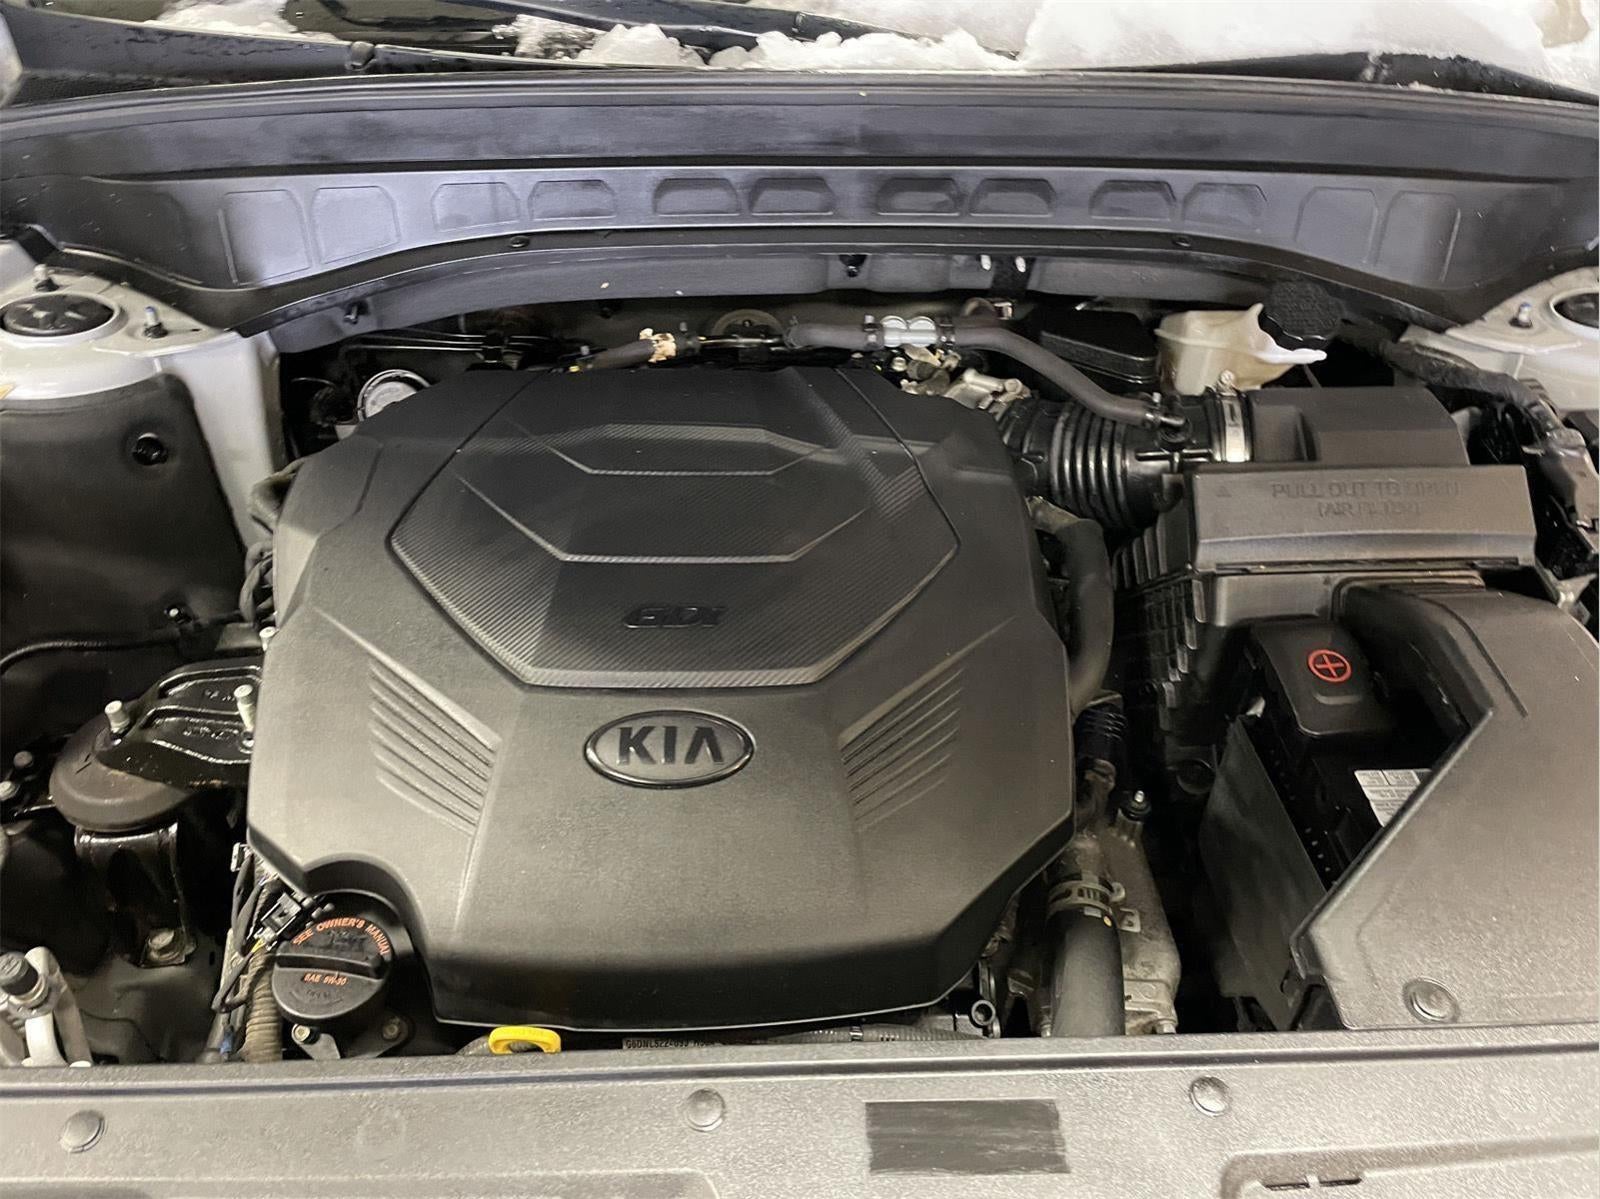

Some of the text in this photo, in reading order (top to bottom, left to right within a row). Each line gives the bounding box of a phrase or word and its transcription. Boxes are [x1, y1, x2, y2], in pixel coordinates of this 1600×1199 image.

[1270, 482, 1323, 499] PULL
[1328, 481, 1366, 498] OUT
[1373, 480, 1402, 497] TO
[617, 724, 725, 766] KIA
[293, 928, 314, 945] SEE
[316, 917, 366, 932] OWNER'S
